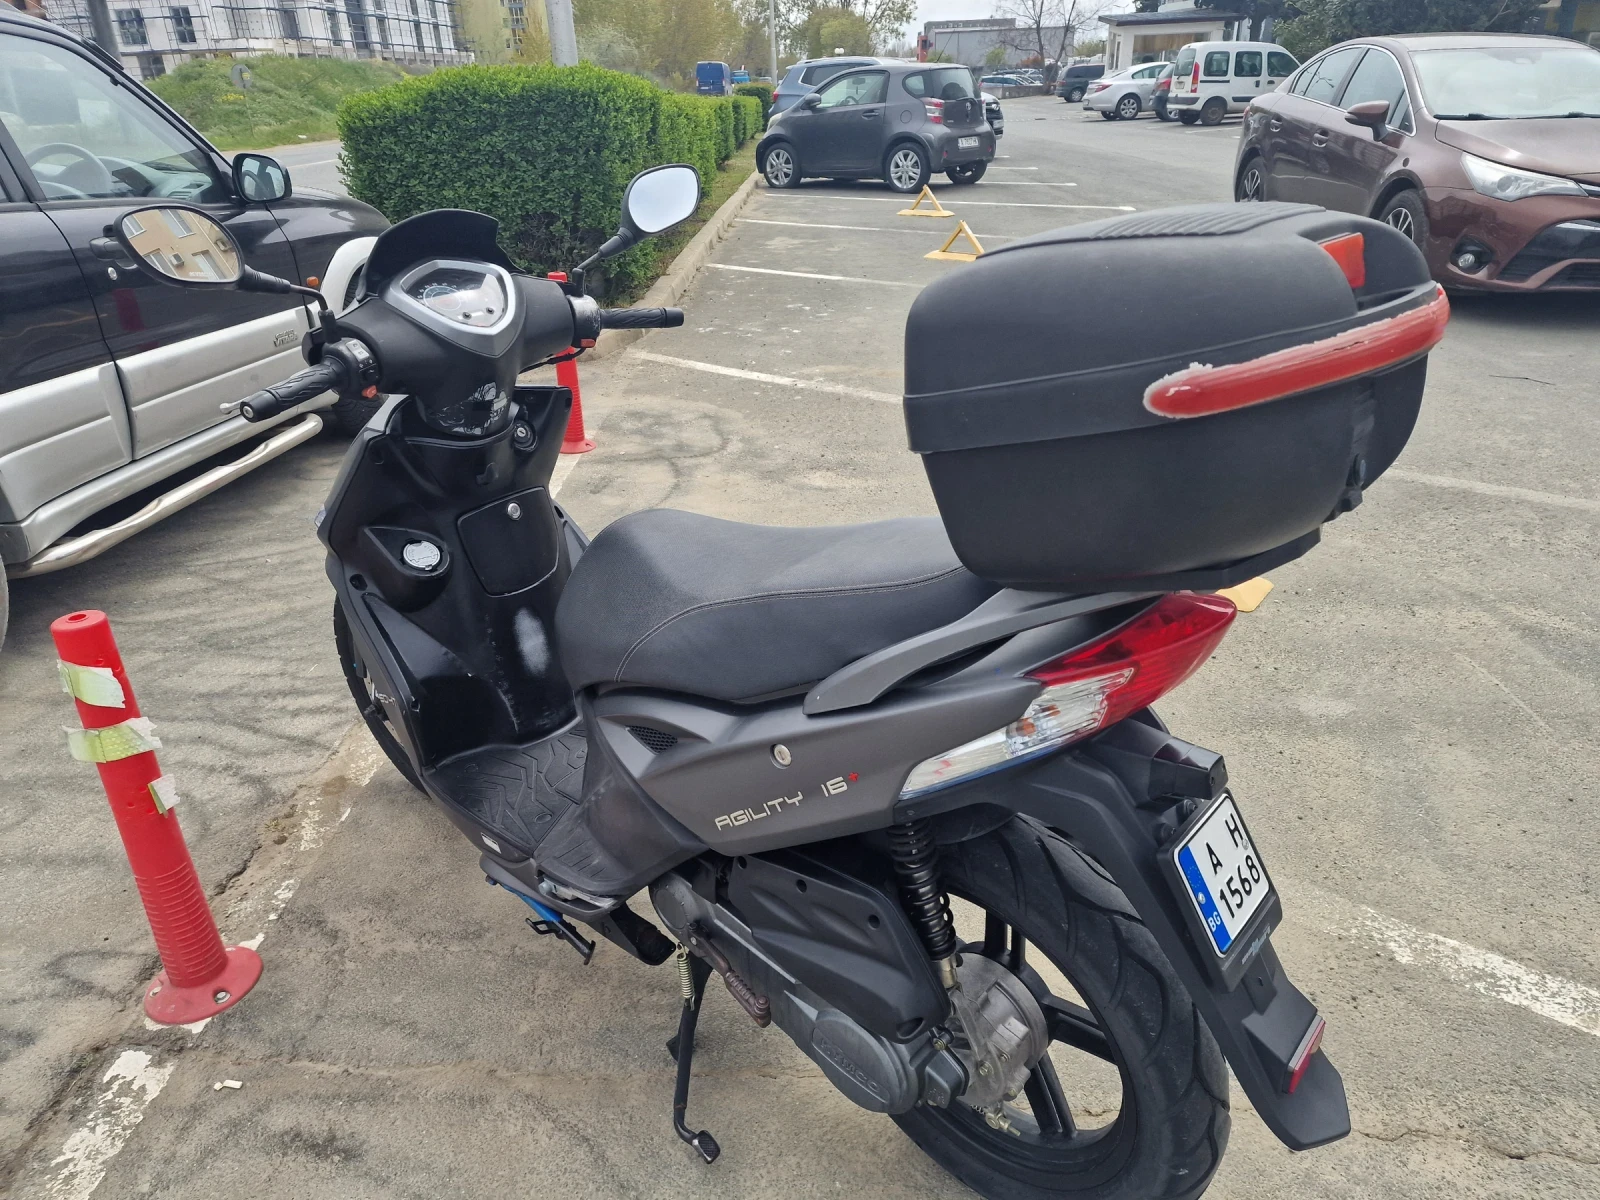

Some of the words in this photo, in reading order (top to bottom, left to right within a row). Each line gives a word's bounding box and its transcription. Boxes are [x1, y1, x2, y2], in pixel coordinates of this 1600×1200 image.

[714, 791, 804, 831] AGILITY
[1205, 842, 1223, 876] A
[1225, 813, 1244, 848] H
[1219, 854, 1261, 919] 1568
[1207, 911, 1222, 932] BG
